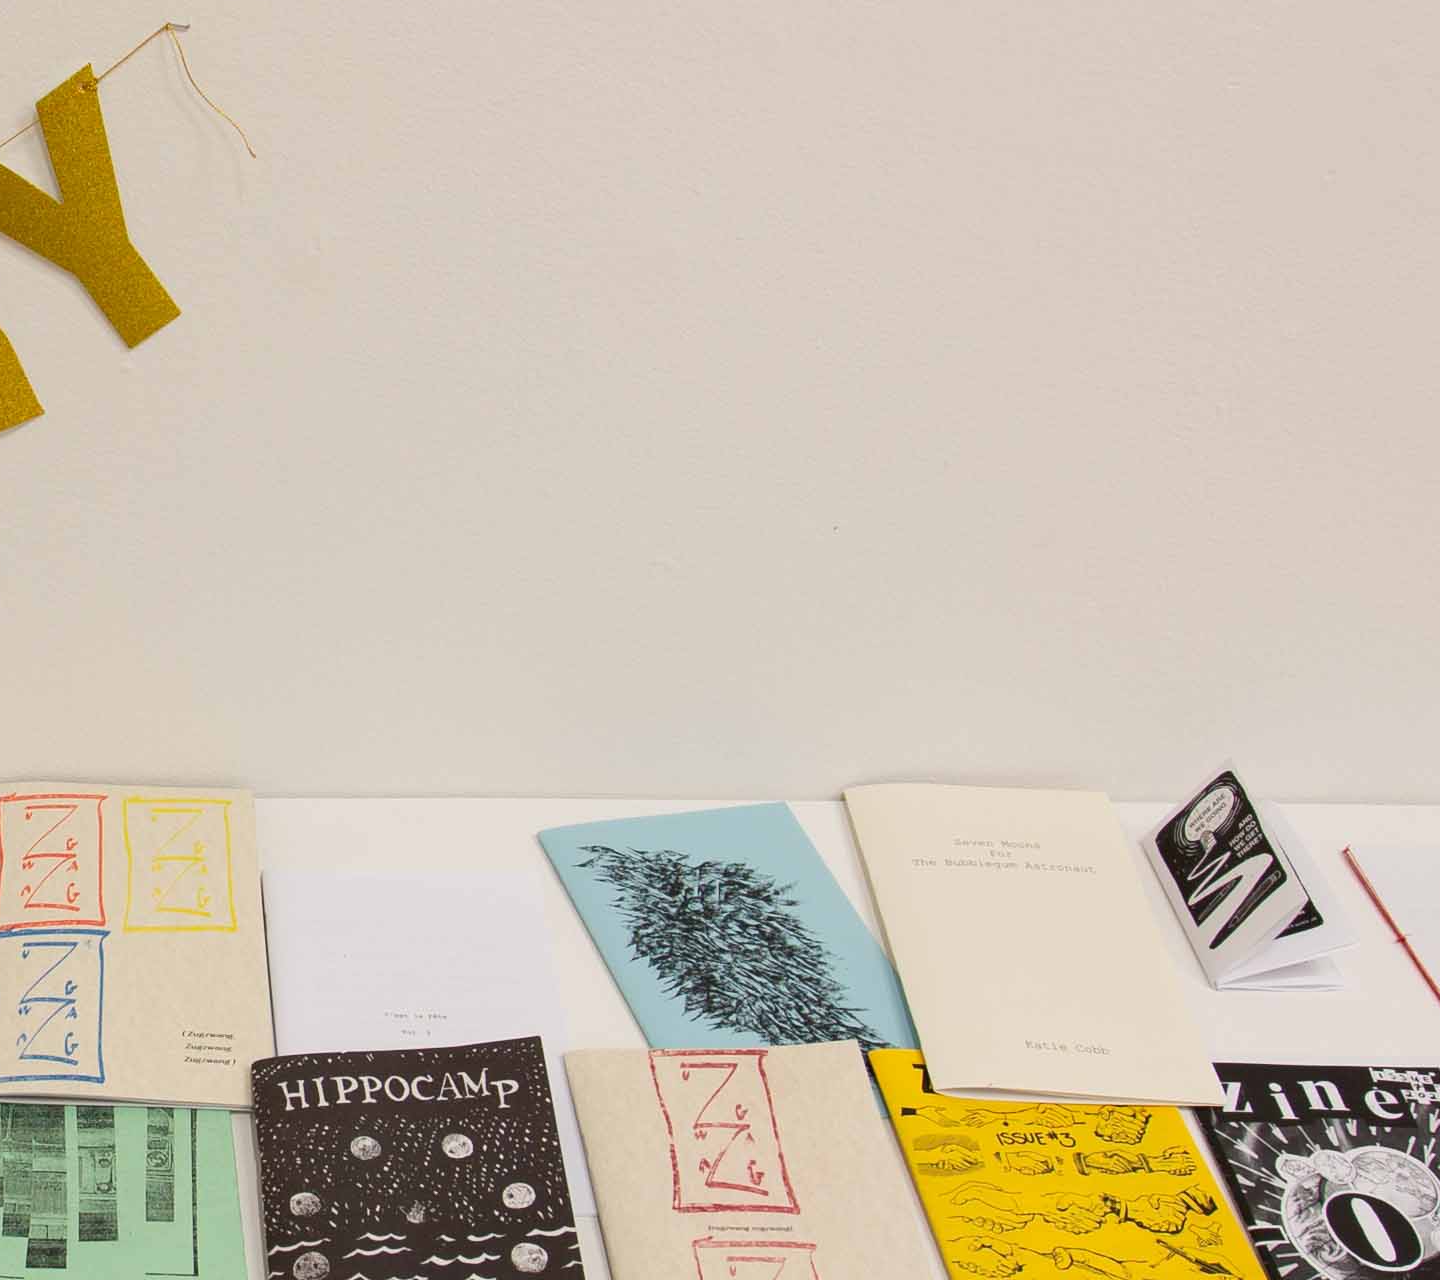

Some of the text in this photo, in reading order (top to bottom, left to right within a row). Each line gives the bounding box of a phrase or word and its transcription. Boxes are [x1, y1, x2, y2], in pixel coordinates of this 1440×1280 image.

[1238, 814, 1253, 830] AND
[953, 838, 994, 848] Seven
[1229, 832, 1246, 848] HOW
[1244, 827, 1260, 844] GET
[911, 857, 937, 867] The
[1024, 1039, 1112, 1056] Katie Cobb
[277, 1067, 520, 1112] HIPPOCAMP
